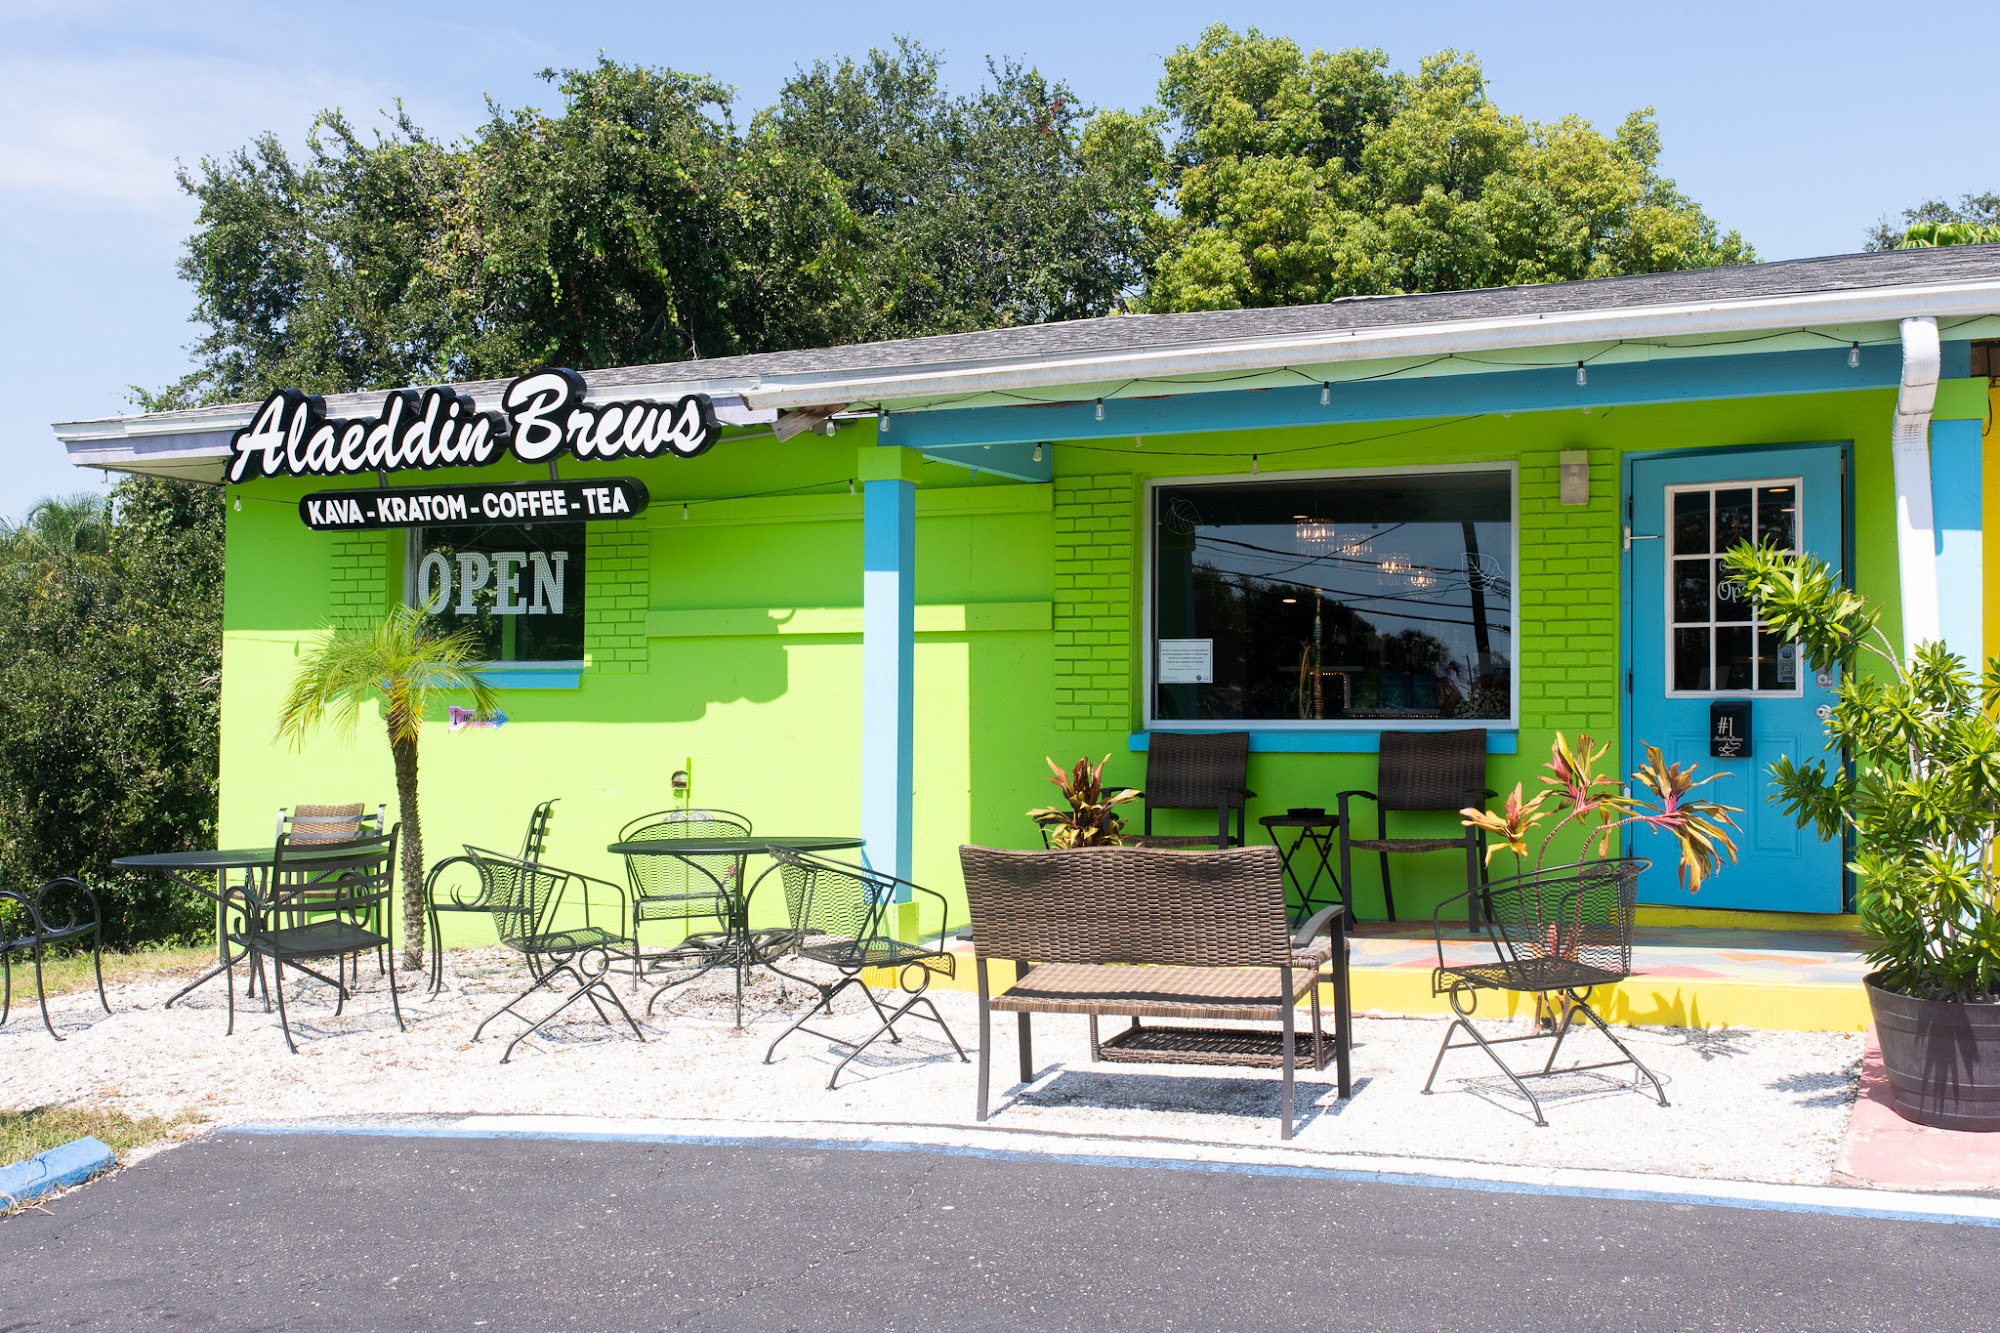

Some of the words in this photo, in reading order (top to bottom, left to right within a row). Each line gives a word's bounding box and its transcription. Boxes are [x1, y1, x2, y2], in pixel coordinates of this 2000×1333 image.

[230, 391, 495, 483] Alaeddin
[507, 372, 708, 461] Brews
[307, 499, 365, 525] KAVA
[377, 494, 468, 523] KRATOM
[482, 489, 568, 519] COFFEE
[582, 486, 630, 515] TEA
[417, 551, 569, 615] OPEN
[1717, 716, 1733, 737] #1
